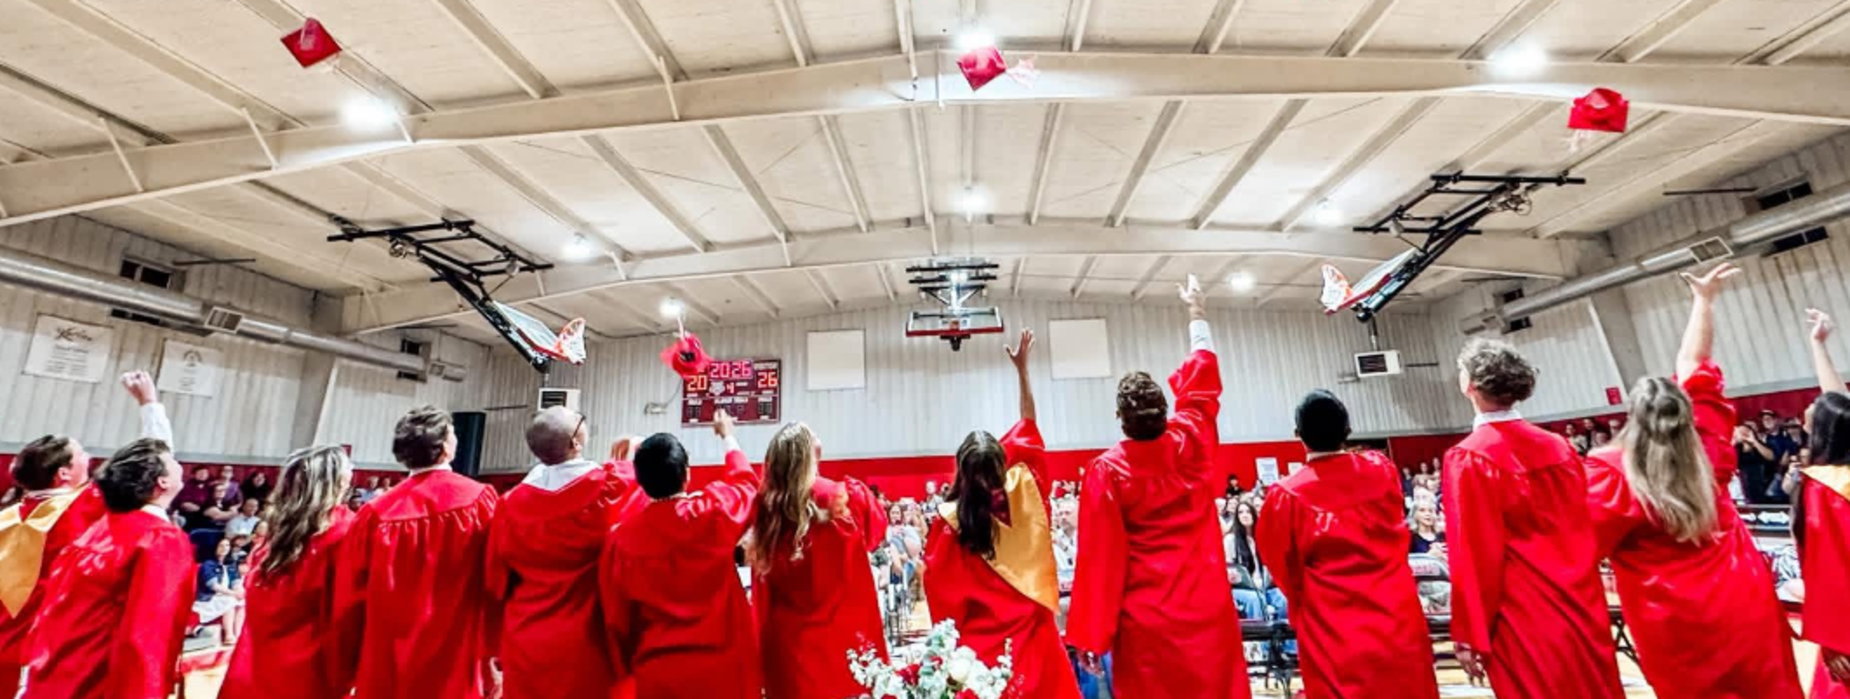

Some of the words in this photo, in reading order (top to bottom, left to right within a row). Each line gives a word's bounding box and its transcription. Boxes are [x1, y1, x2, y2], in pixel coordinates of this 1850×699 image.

[710, 361, 752, 378] 2026
[687, 375, 707, 391] 20
[726, 382, 735, 393] 4
[757, 371, 777, 388] 26
